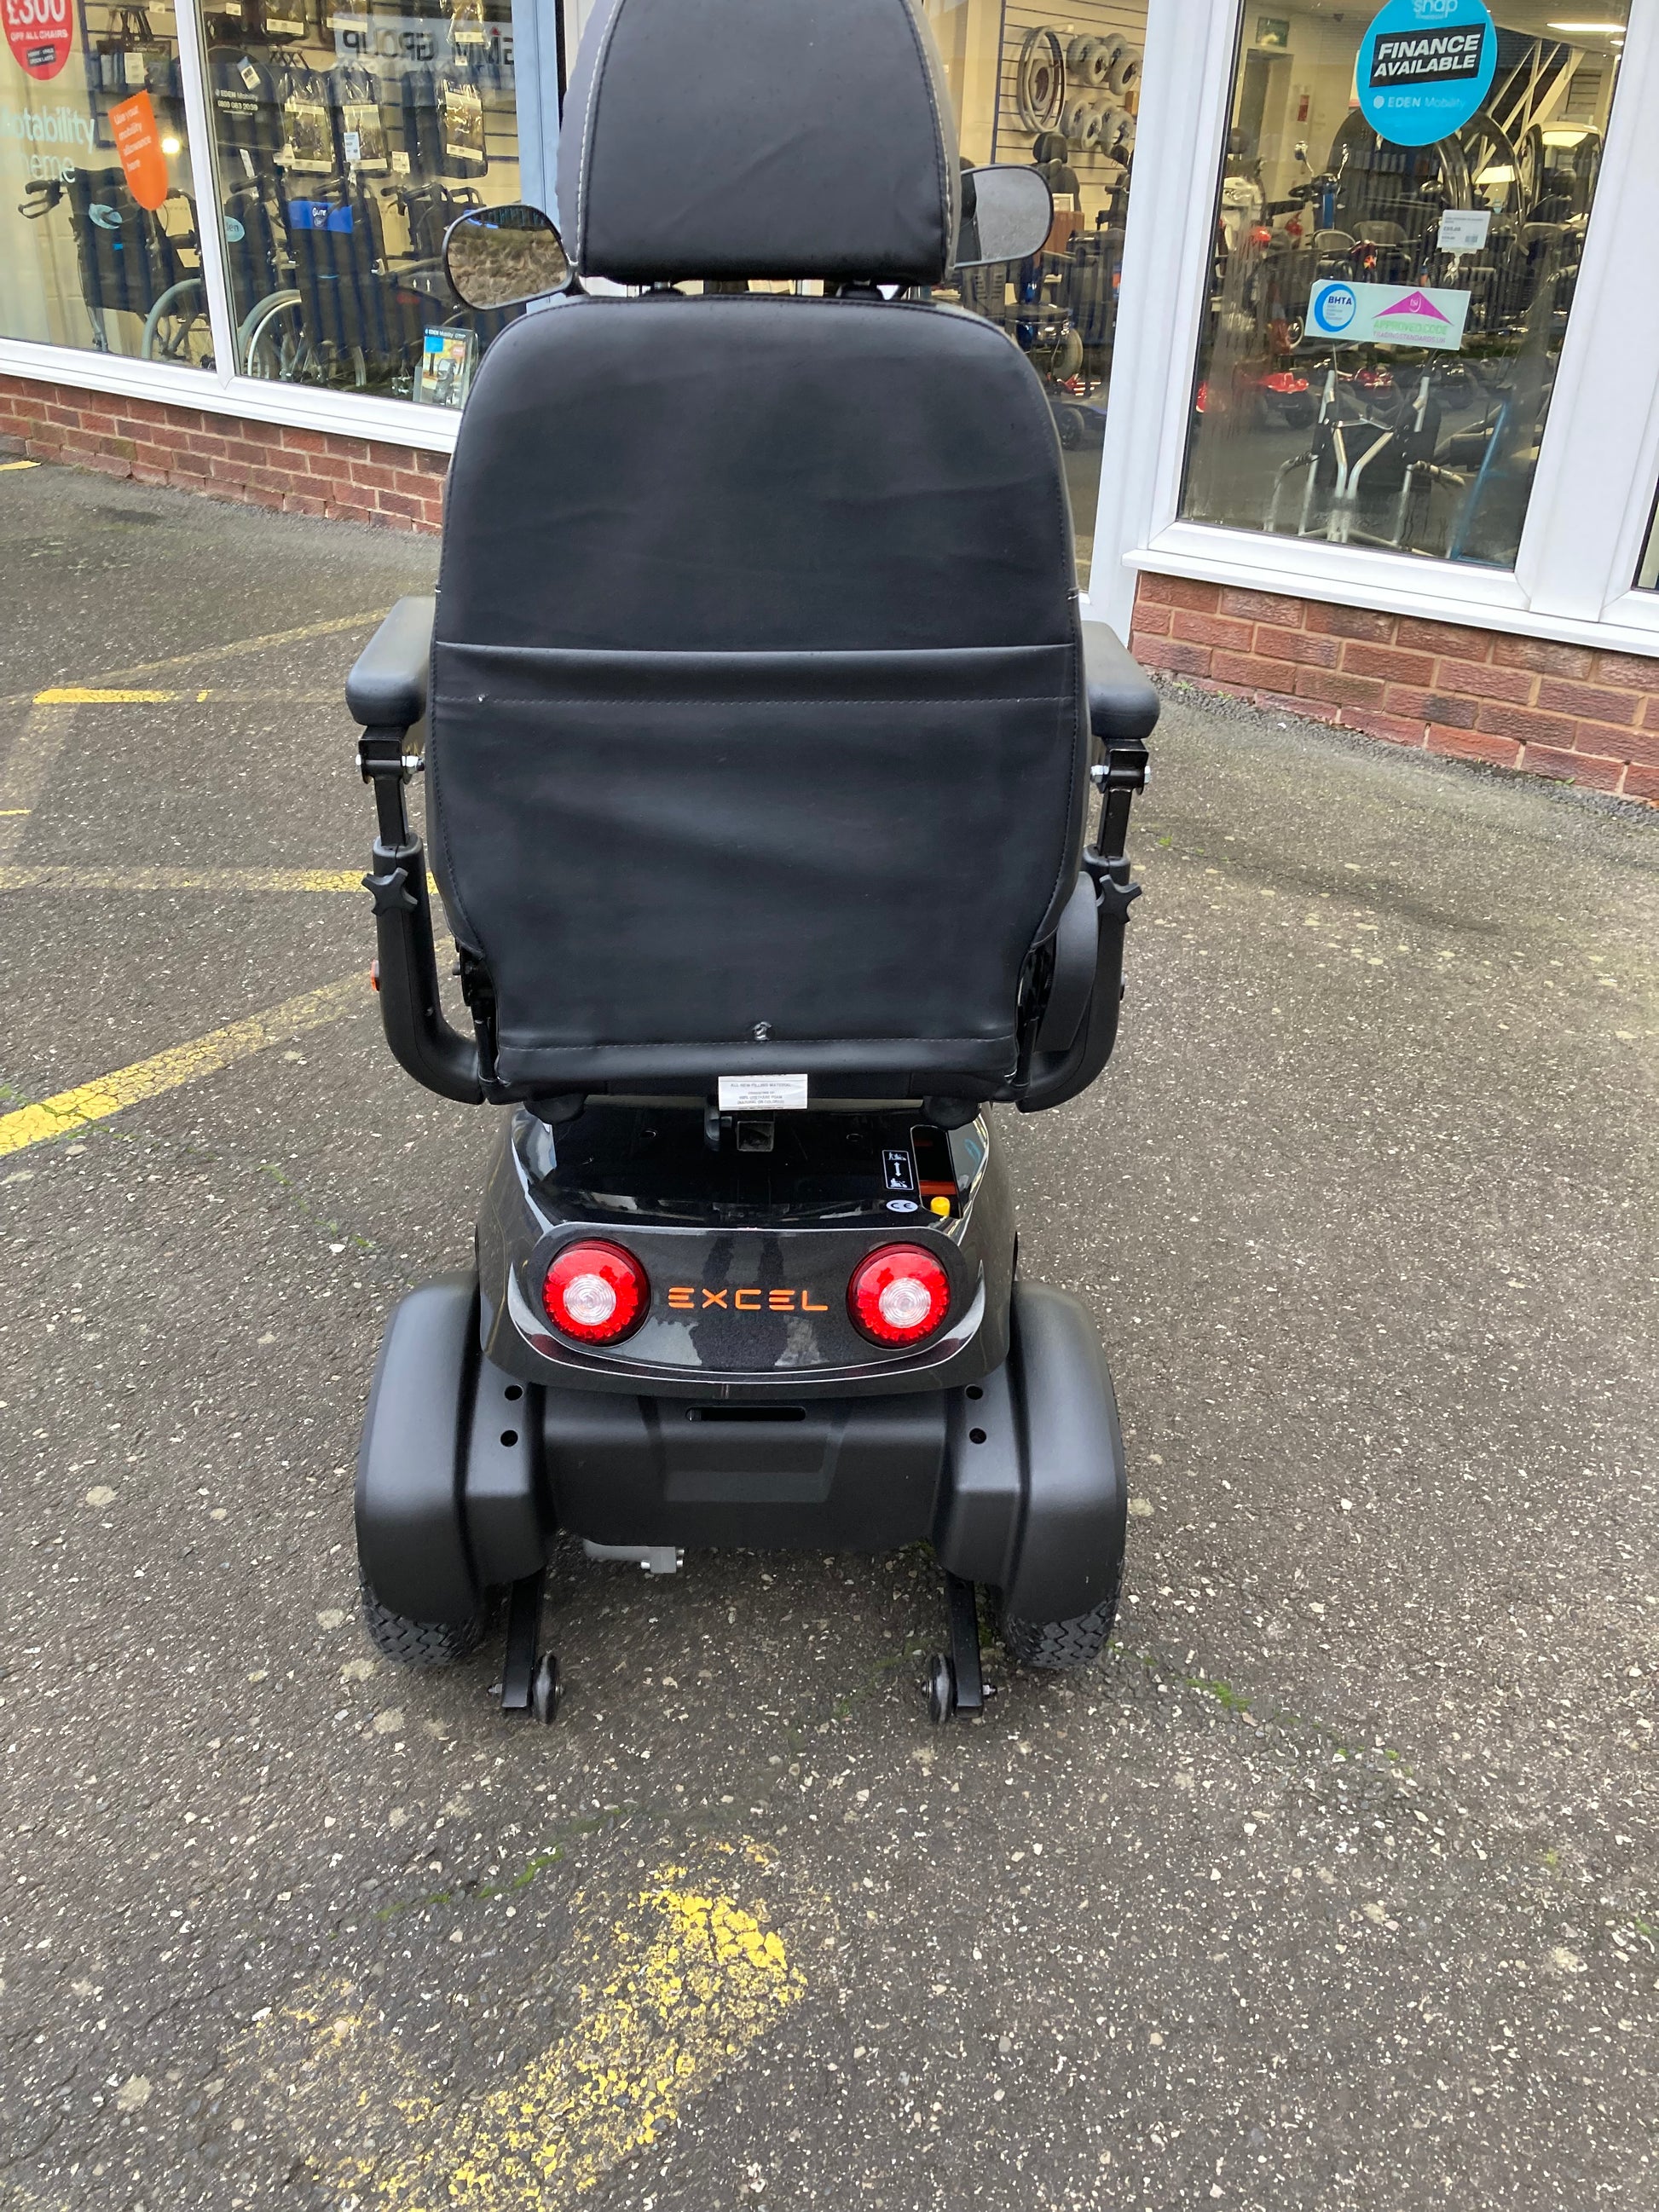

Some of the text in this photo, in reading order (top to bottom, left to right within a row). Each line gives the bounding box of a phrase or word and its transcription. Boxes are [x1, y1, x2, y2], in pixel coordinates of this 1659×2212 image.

[25, 31, 39, 40] ALL
[39, 29, 68, 39] CHAIRS
[1378, 33, 1481, 61] FINANCE
[1373, 54, 1477, 78] AVAILABLE
[221, 90, 236, 98] EDEN
[1387, 96, 1466, 110] EDEN Mobility
[1328, 296, 1352, 305] BHTA
[668, 1287, 828, 1311] EXCEL
